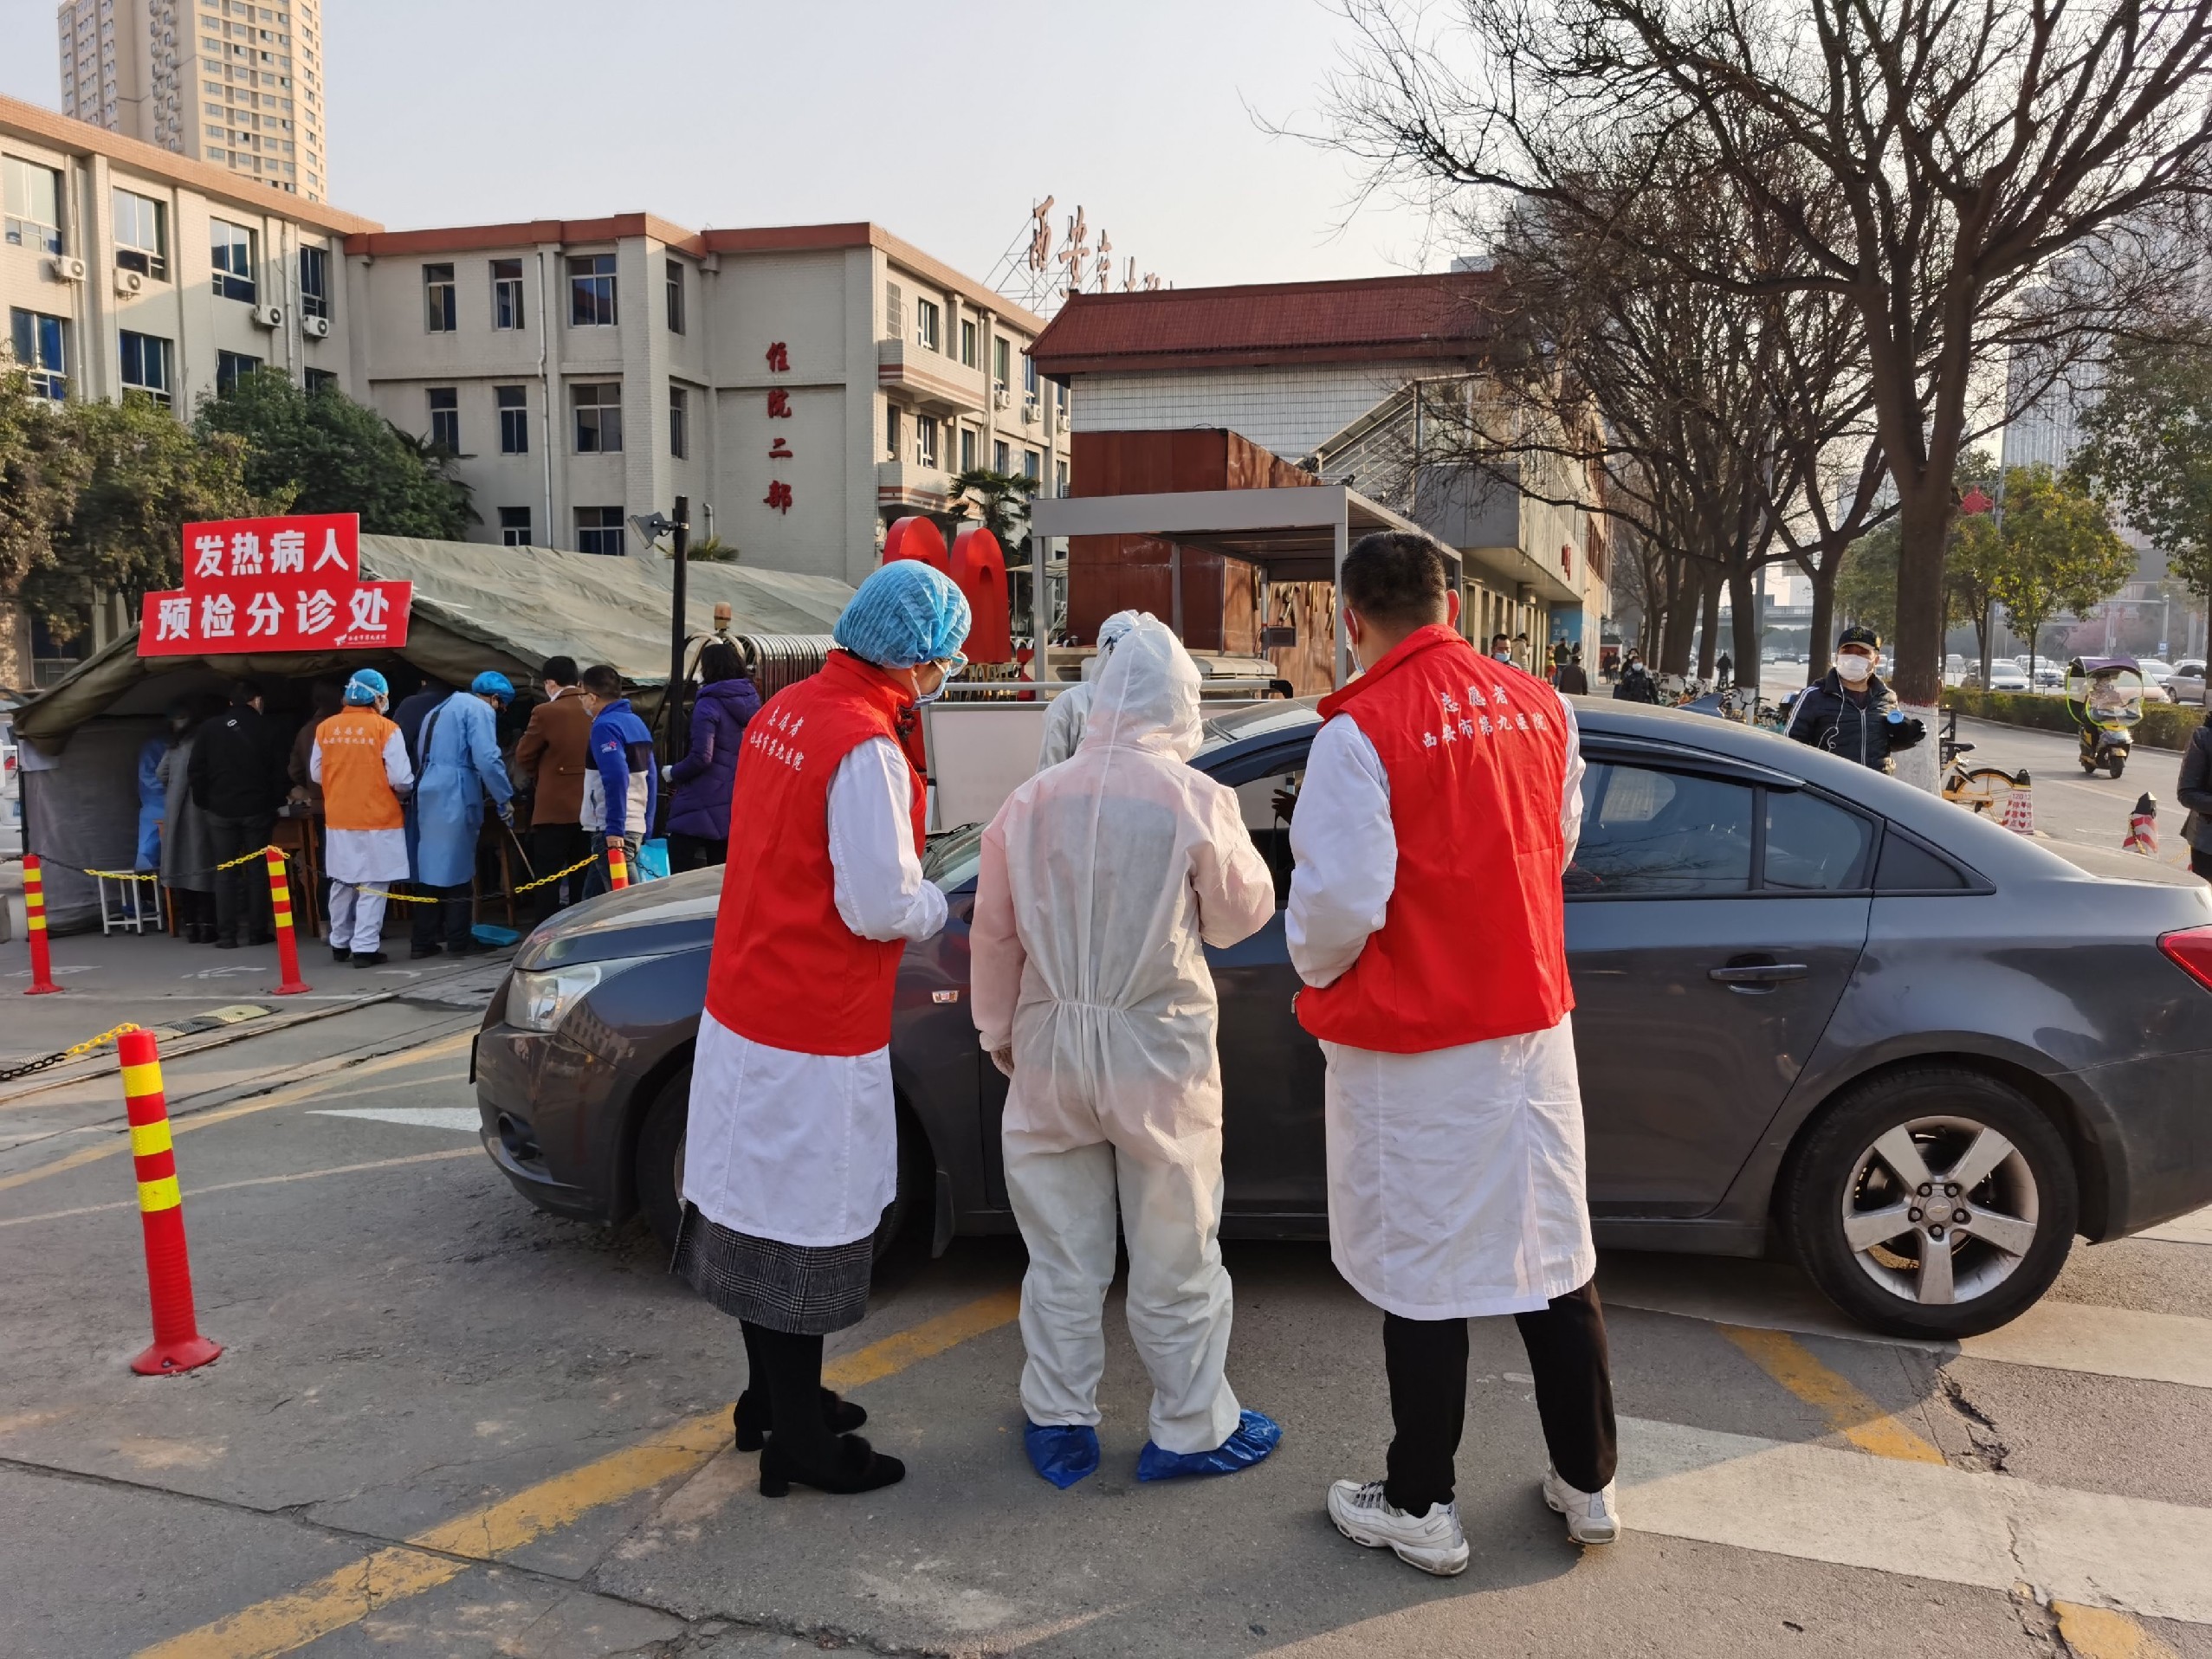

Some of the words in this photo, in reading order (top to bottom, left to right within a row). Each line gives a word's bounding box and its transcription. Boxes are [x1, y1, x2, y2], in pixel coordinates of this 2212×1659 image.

[763, 342, 793, 515] 住院二部
[195, 528, 349, 578] 发热病人
[156, 588, 389, 642] 预检分诊处
[1441, 684, 1508, 713] 志愿者
[1422, 713, 1549, 748] 西安市第九医院
